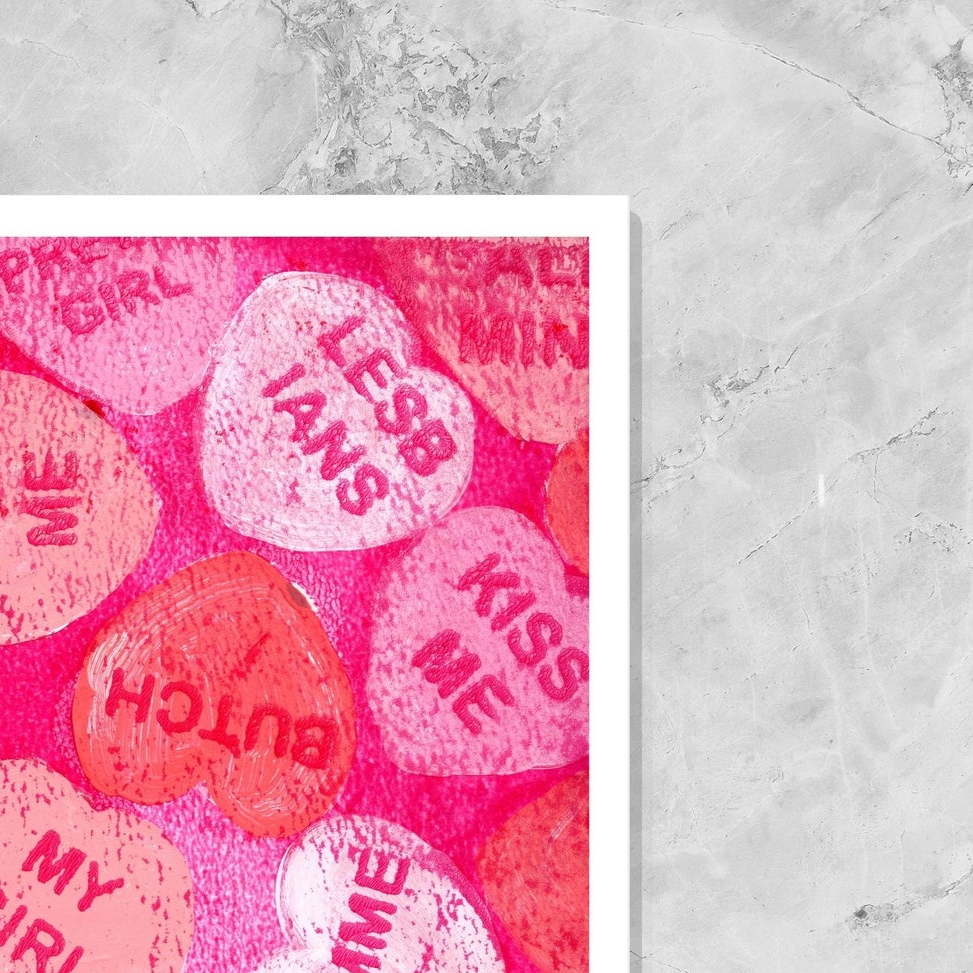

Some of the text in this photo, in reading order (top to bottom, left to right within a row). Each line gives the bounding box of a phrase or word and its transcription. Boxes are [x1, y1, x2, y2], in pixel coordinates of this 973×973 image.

[60, 264, 193, 335] GIRL
[264, 364, 388, 516] IANS
[320, 317, 456, 477] LESB
[23, 450, 81, 547] ME
[458, 552, 589, 700] KISS
[105, 668, 338, 769] BUTCH
[412, 629, 514, 733] ME
[22, 830, 124, 911] MY
